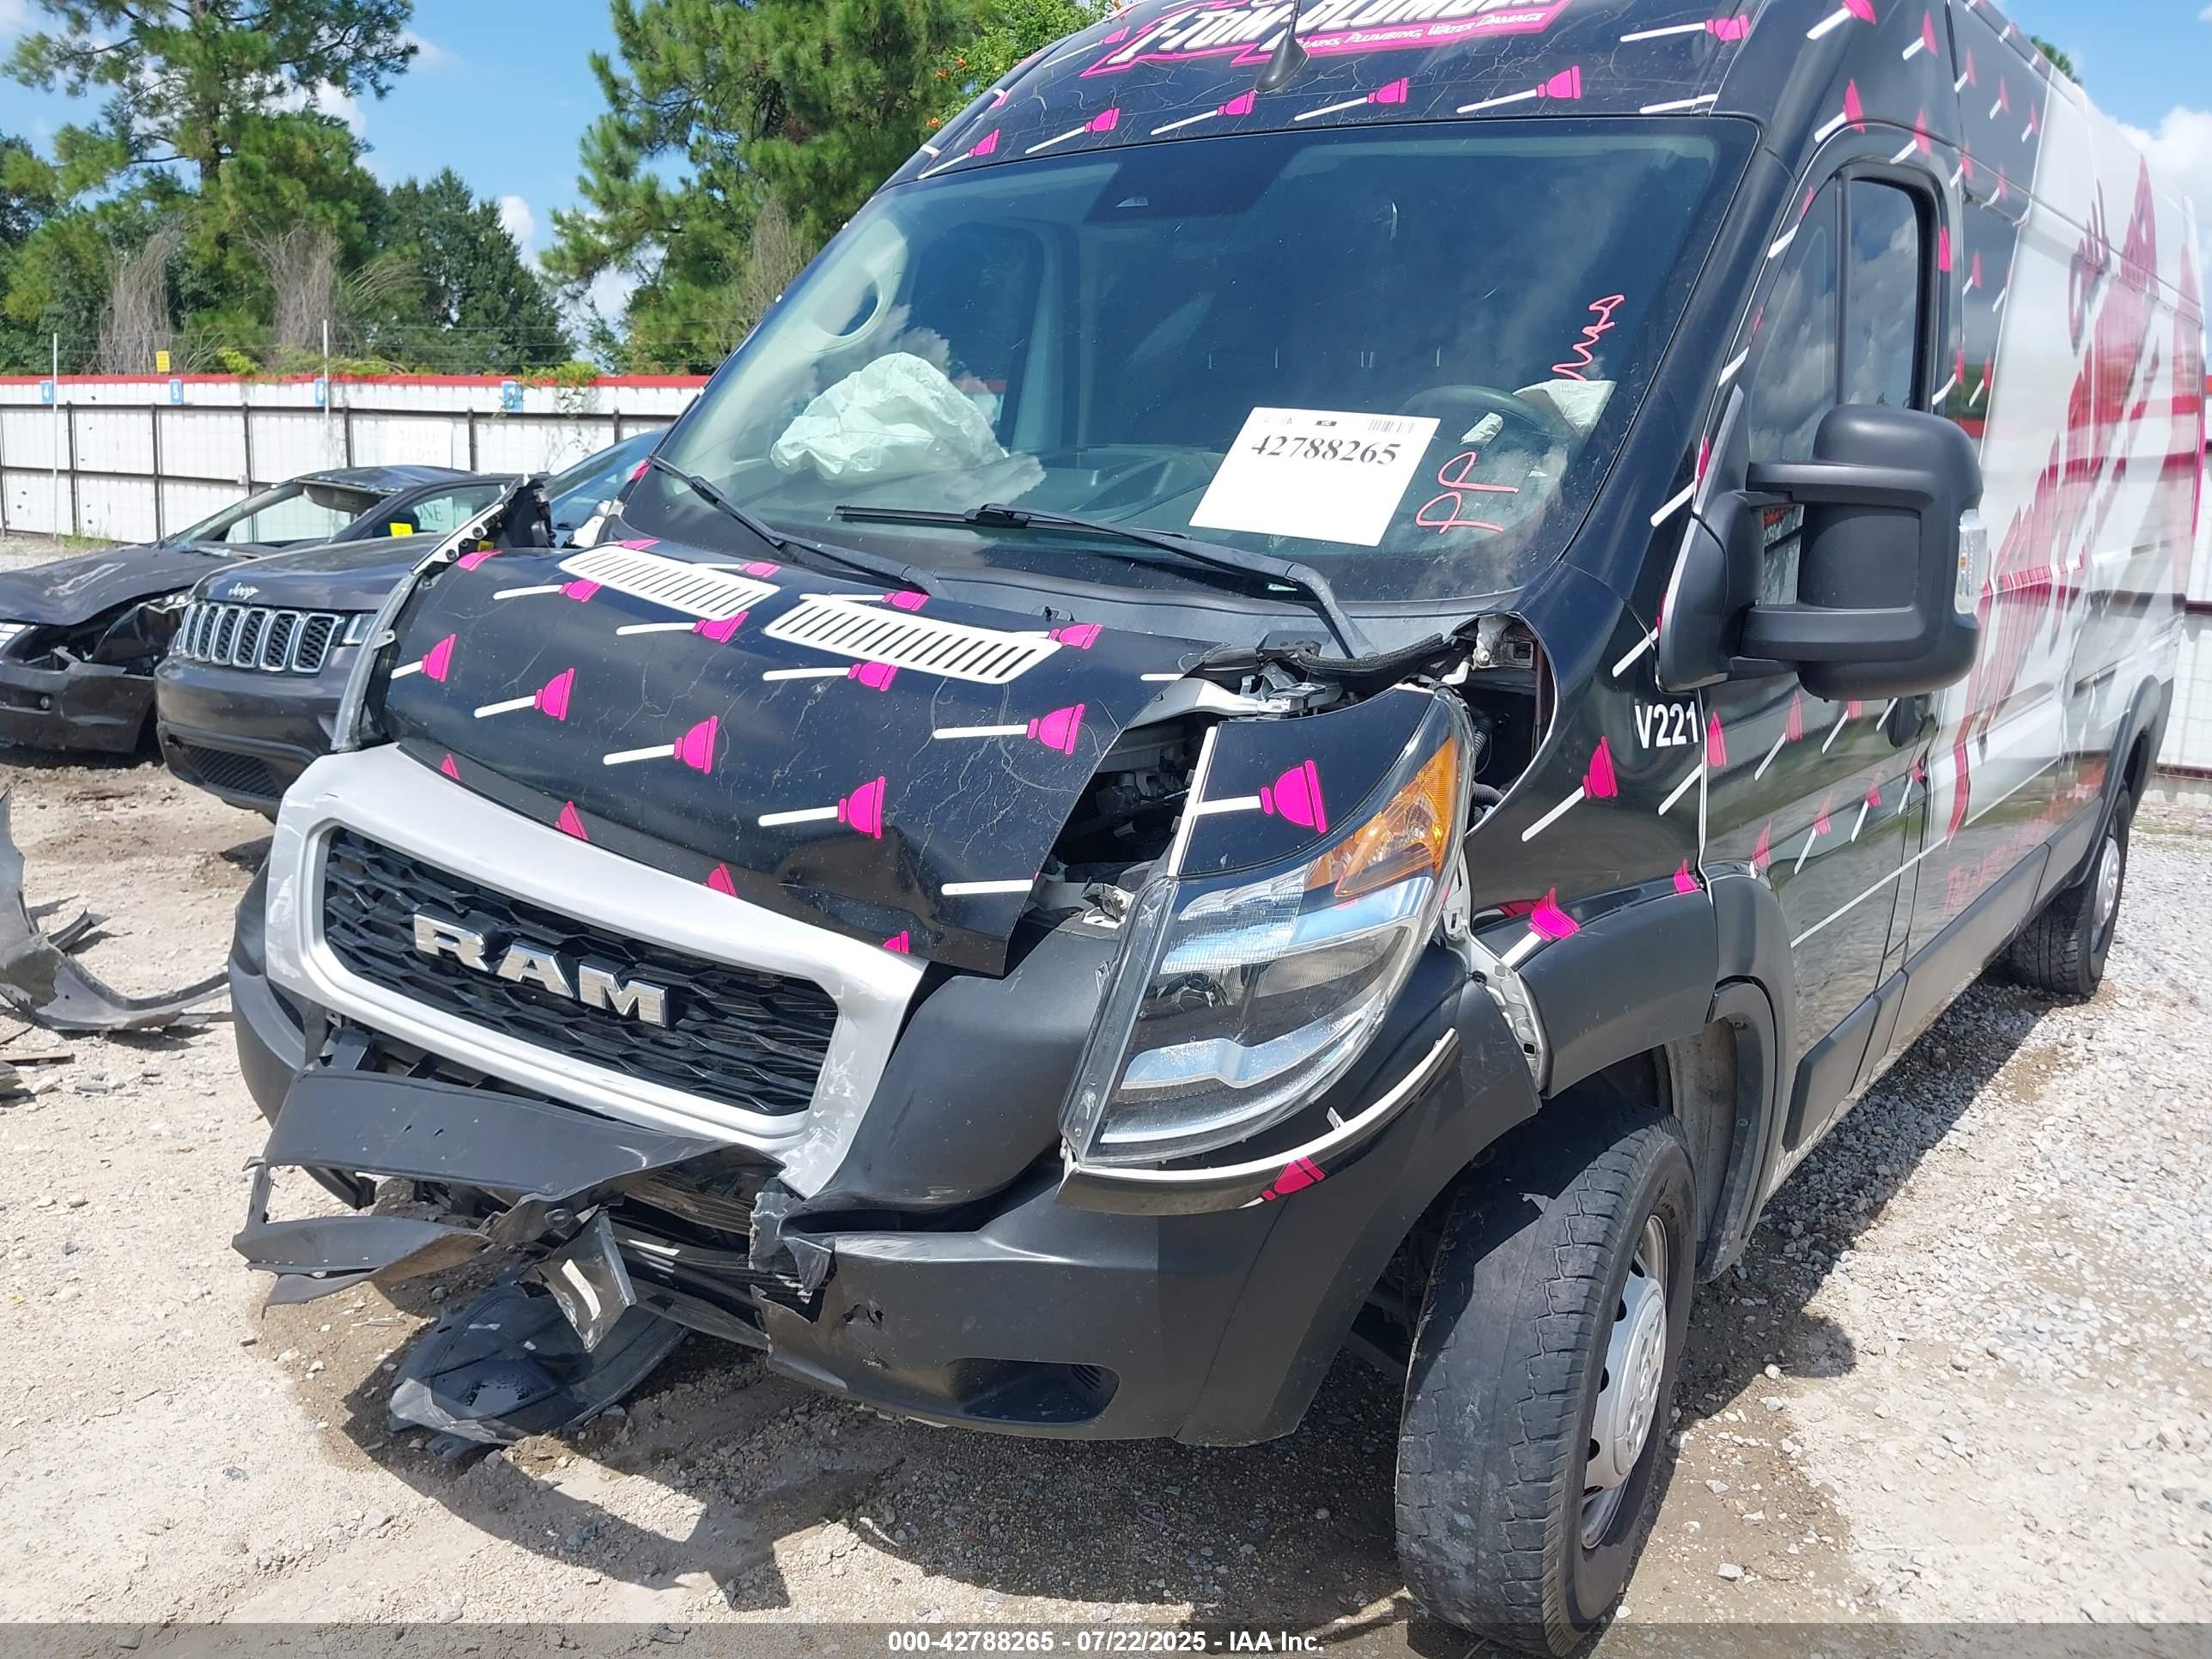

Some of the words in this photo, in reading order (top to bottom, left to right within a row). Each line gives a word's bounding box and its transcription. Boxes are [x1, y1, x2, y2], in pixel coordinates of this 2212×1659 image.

[1250, 434, 1401, 465] 42788265
[228, 582, 259, 600] Jeep
[1634, 701, 1699, 749] V221
[414, 914, 670, 1029] RAM
